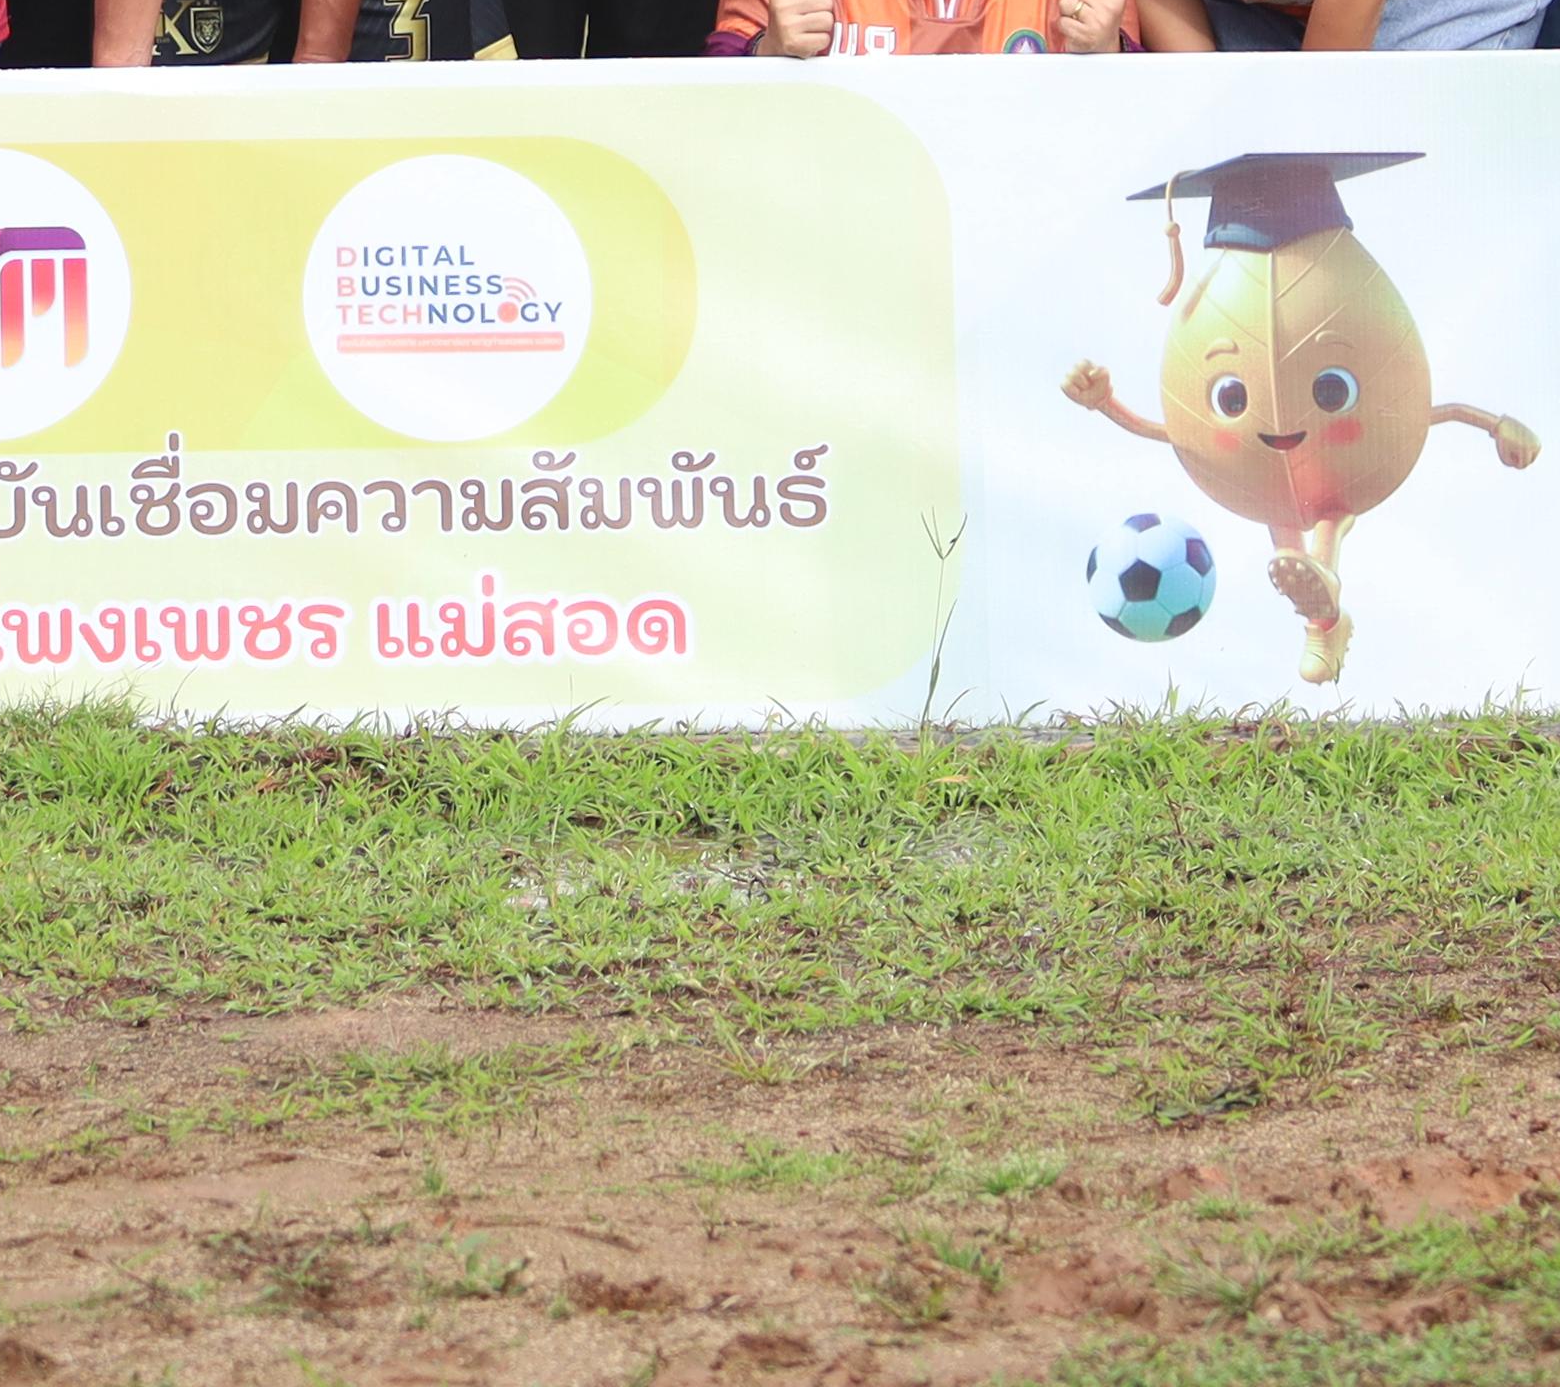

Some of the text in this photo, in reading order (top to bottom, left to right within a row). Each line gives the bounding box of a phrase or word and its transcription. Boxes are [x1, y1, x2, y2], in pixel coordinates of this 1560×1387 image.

[336, 245, 475, 267] DIGITAL
[336, 274, 503, 297] BUSINESS
[336, 301, 563, 325] TECHNOLOGY
[376, 573, 688, 659] แม่สอด
